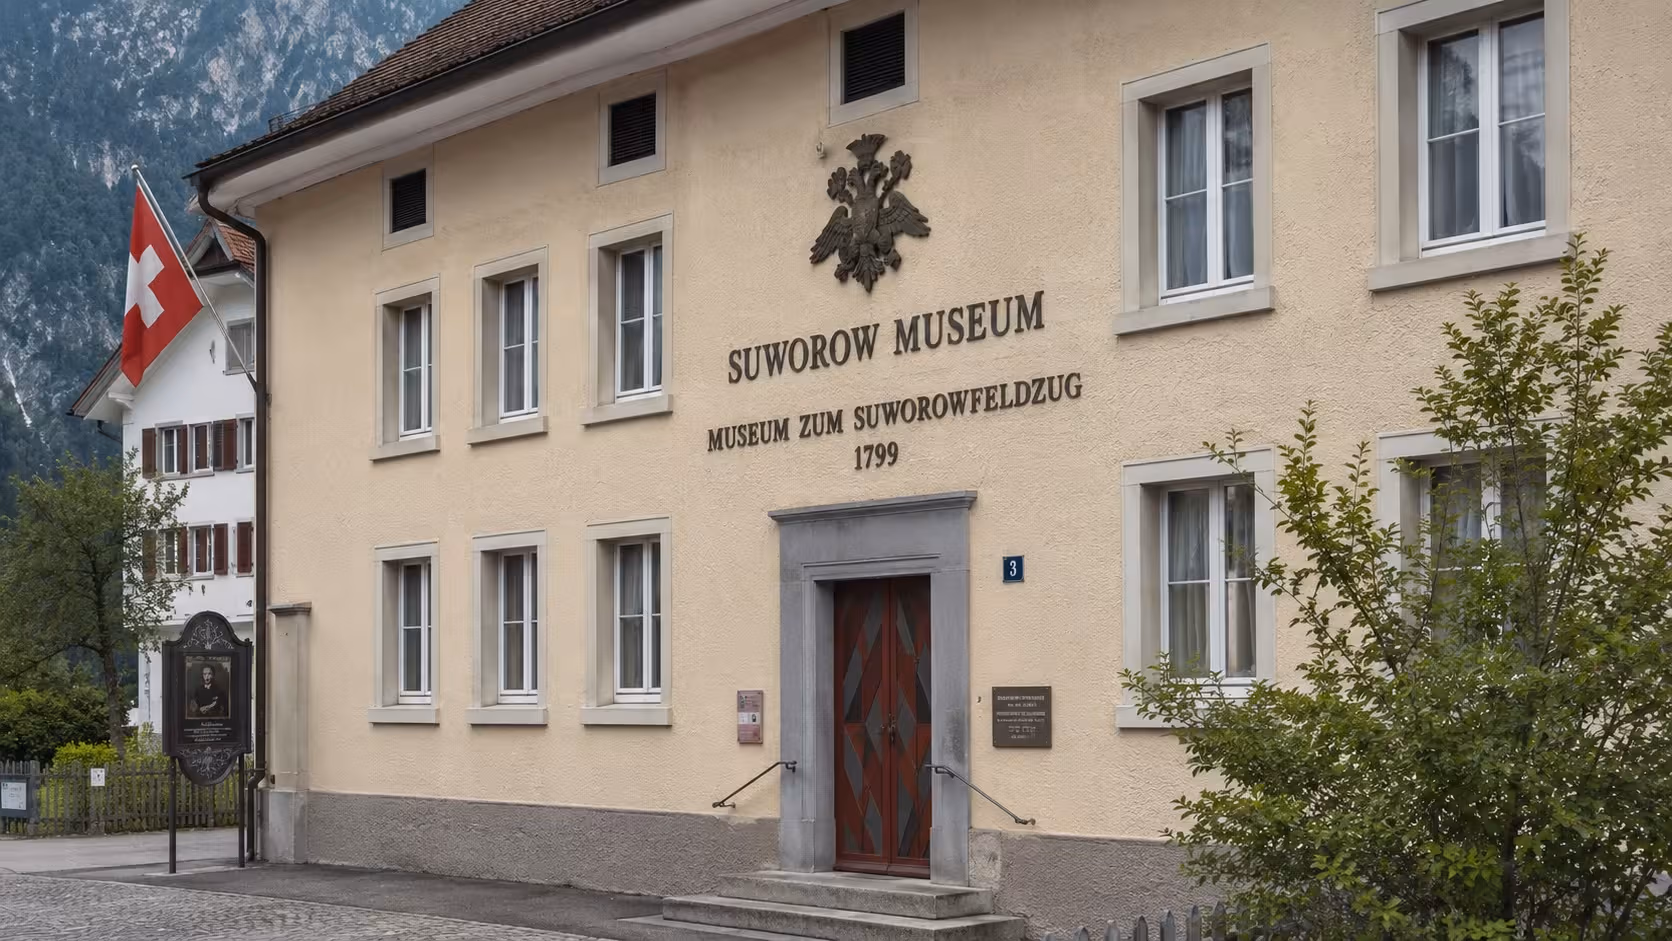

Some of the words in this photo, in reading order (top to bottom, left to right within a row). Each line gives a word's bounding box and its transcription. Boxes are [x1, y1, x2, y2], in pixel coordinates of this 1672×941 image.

[728, 323, 880, 384] SUWOROW
[893, 290, 1045, 355] MUSEUM
[707, 418, 790, 452] MUSEUM
[798, 409, 844, 439] ZUM
[853, 372, 1083, 431] SUWOROWFELDZUG
[854, 441, 899, 470] 1799
[1009, 560, 1017, 577] 3
